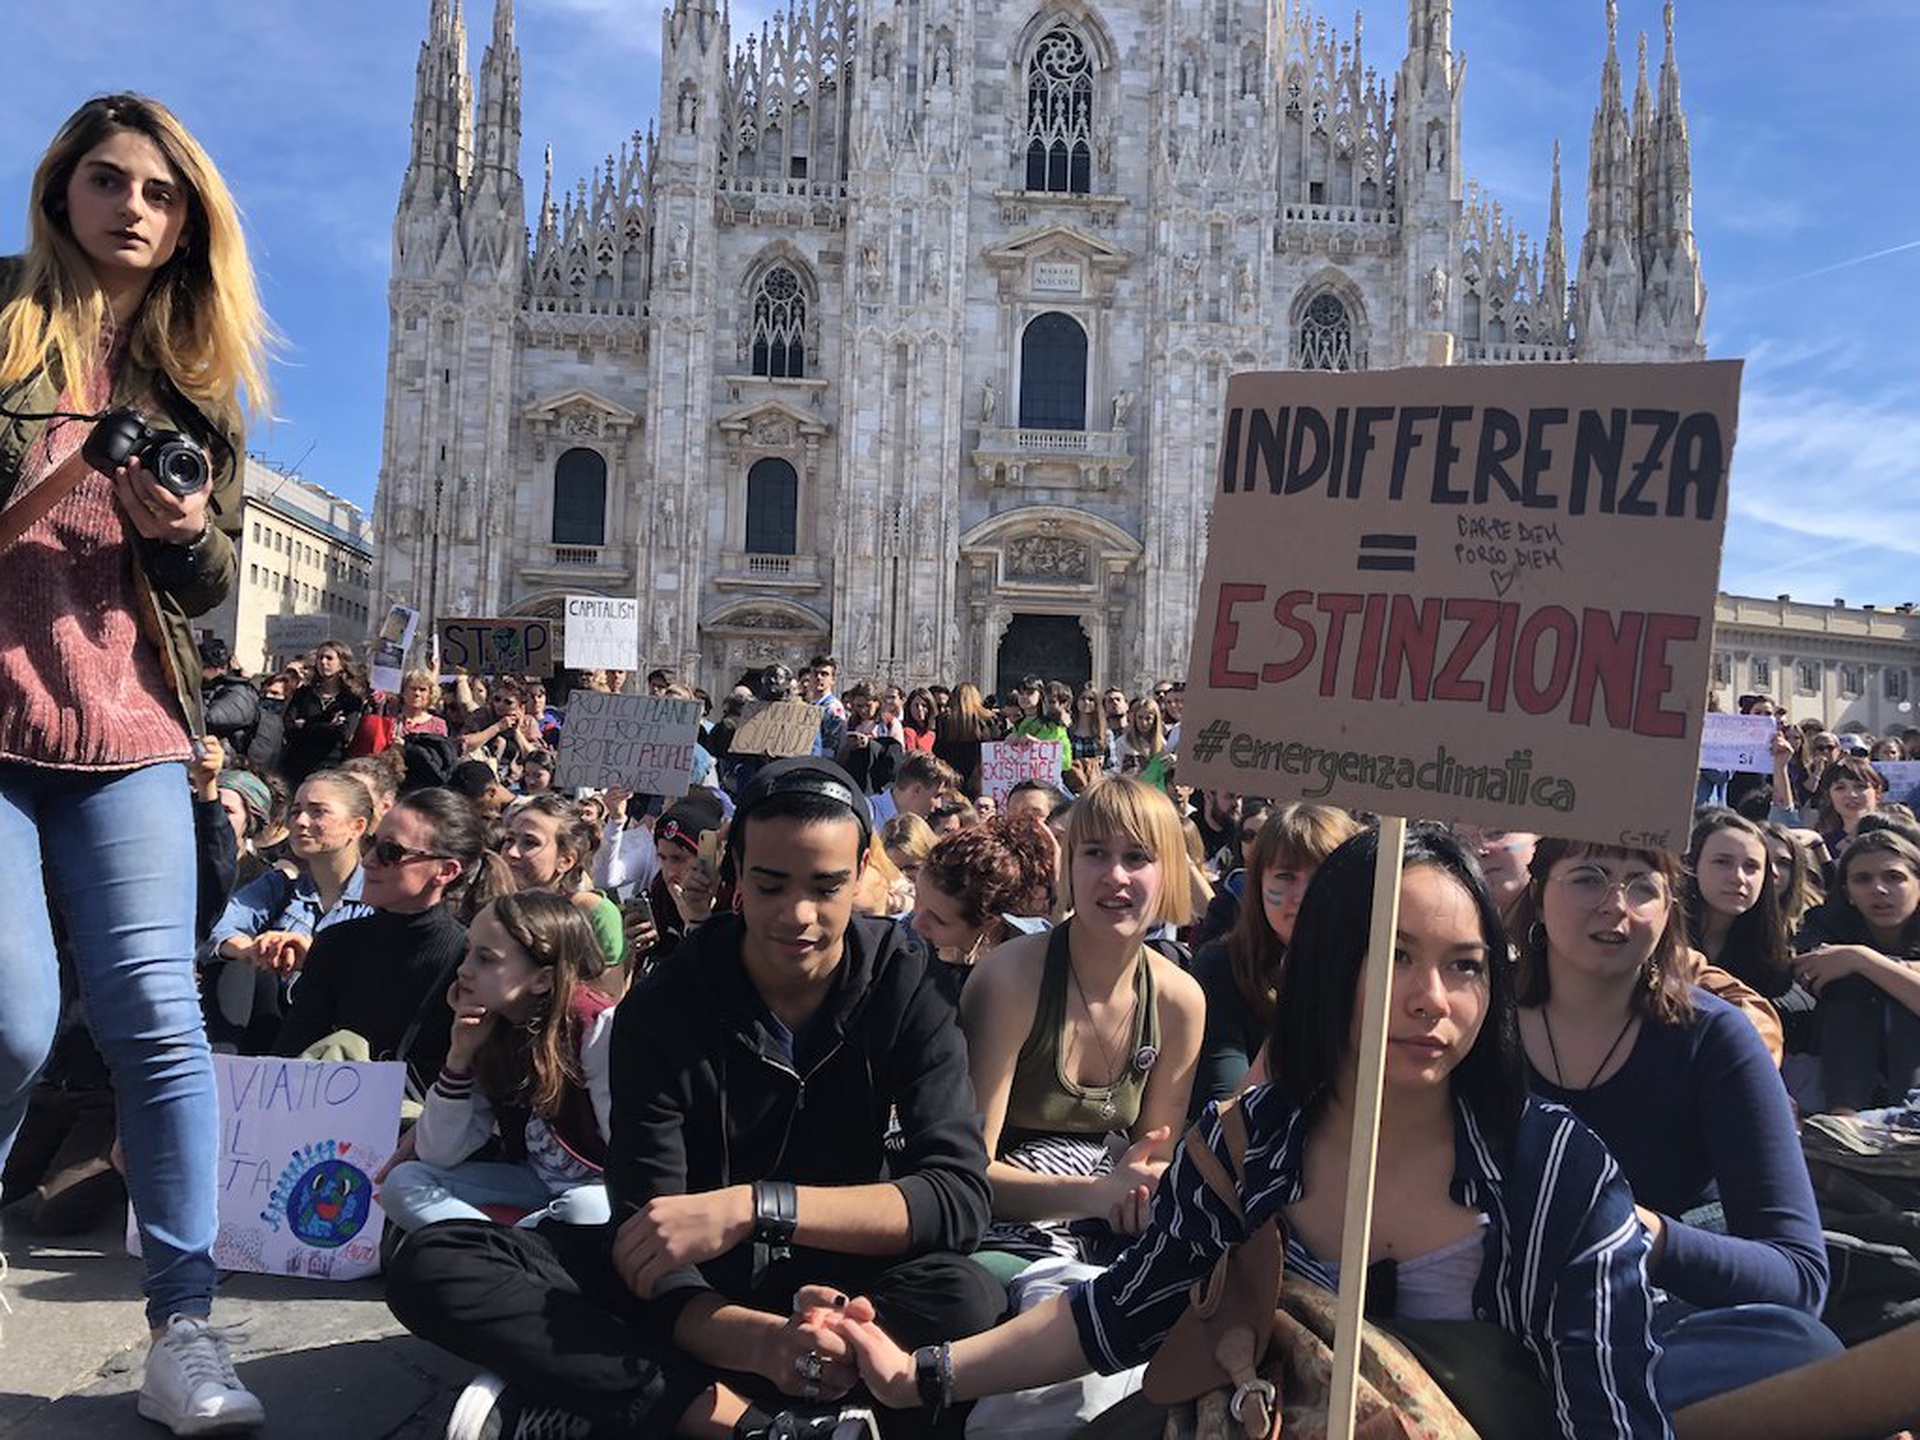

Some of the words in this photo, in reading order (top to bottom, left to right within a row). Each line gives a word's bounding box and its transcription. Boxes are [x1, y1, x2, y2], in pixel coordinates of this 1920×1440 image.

[1223, 405, 1725, 520] INDIFFERENZA
[1455, 543, 1507, 565] PORCO
[568, 600, 636, 619] CAPITALISM
[1208, 582, 1701, 739] ESTINZIONE
[560, 736, 640, 767] PROTECT
[637, 743, 695, 772] PEOPLE
[993, 741, 1060, 760] RESPECT
[983, 760, 1055, 781] EXISTENCE
[1193, 719, 1576, 812] #emergenzaclimatica
